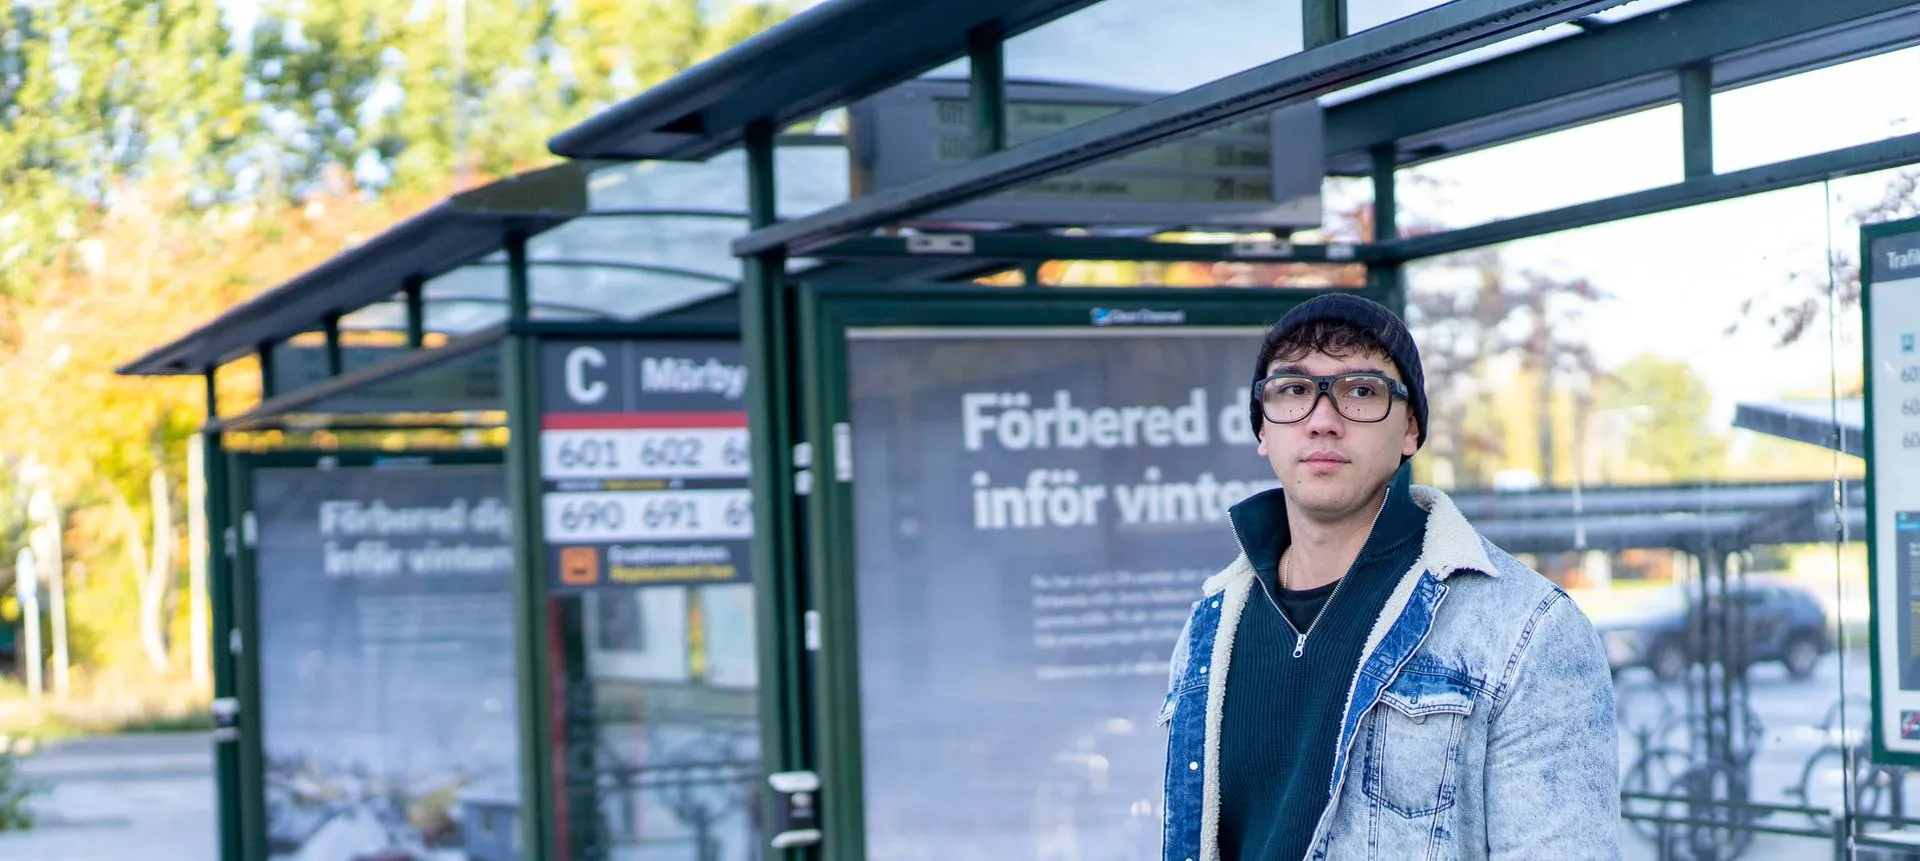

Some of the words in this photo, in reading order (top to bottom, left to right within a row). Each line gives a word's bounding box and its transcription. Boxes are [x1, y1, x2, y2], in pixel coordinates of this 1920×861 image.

[565, 346, 608, 403] C
[641, 357, 748, 400] Mörby
[962, 389, 1210, 450] Förbered
[558, 438, 621, 468] 601
[641, 437, 703, 468] 602
[560, 499, 625, 532] 690
[643, 498, 703, 530] 691
[971, 468, 1106, 530] inför
[1112, 466, 1279, 524] vinte
